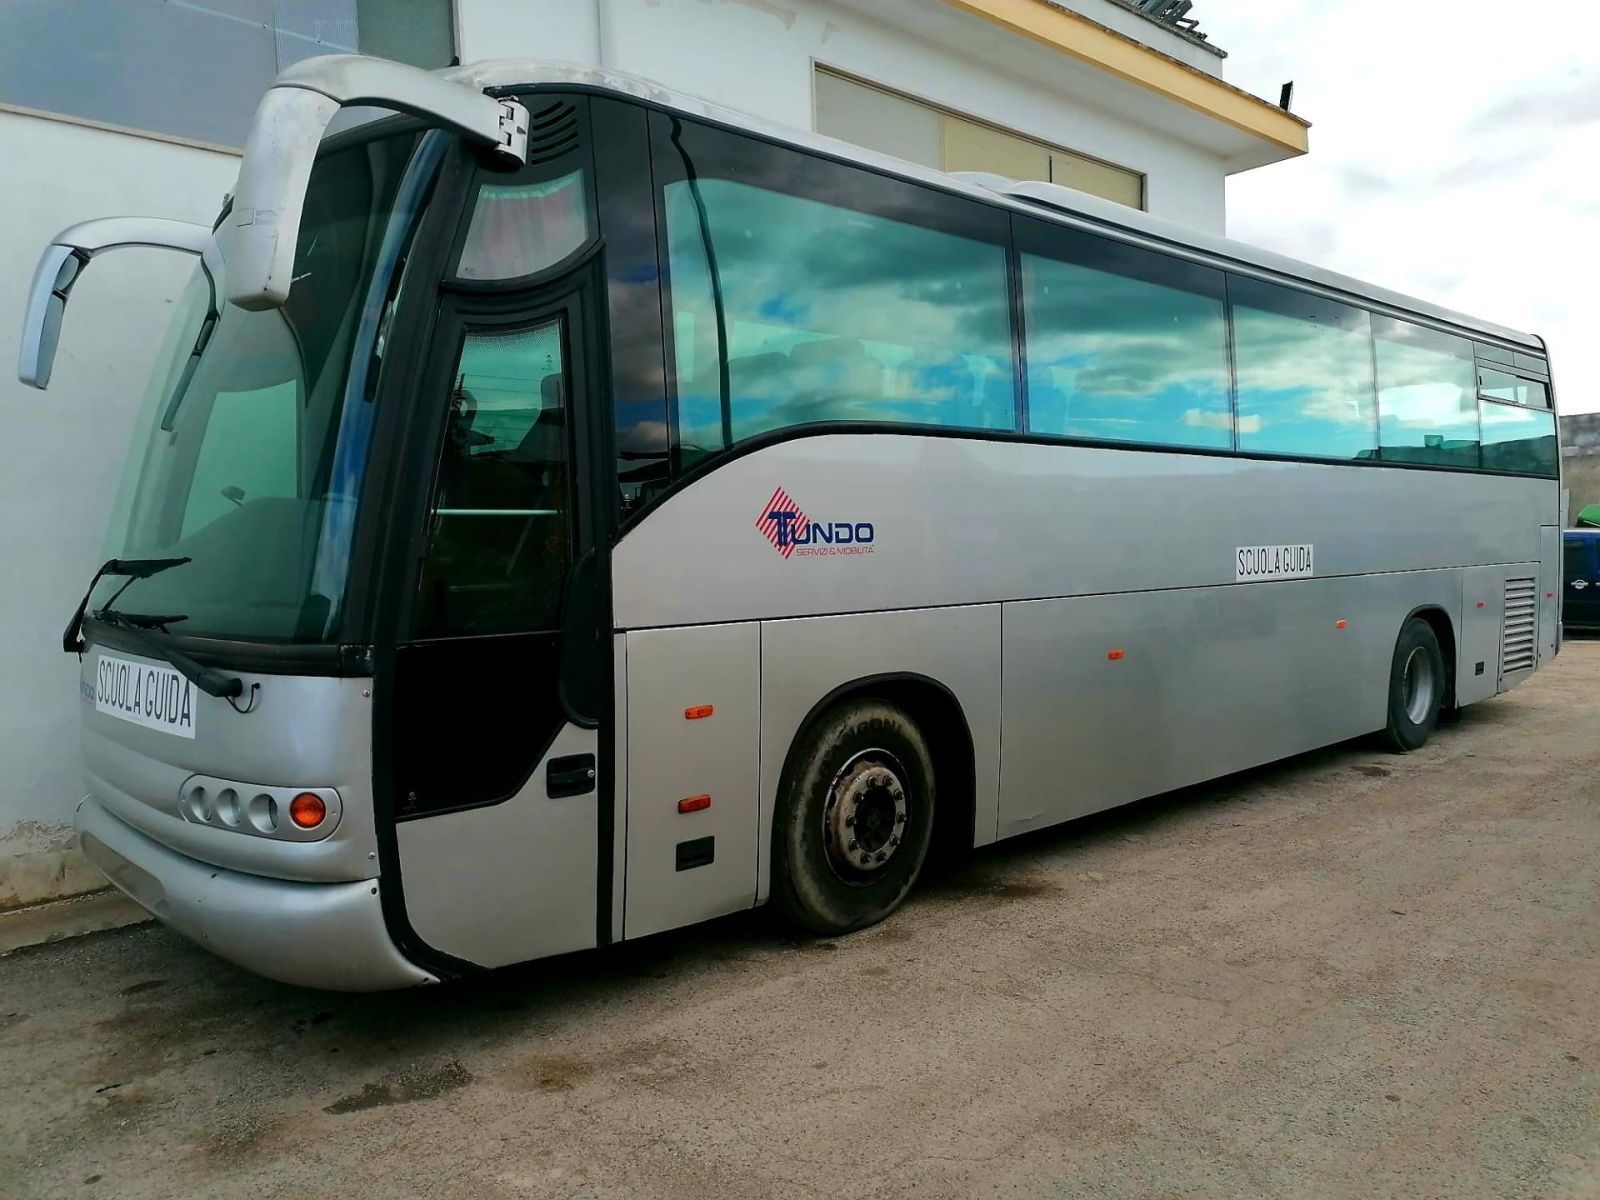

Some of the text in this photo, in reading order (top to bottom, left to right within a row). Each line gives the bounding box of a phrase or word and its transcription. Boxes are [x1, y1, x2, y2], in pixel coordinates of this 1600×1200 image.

[767, 511, 874, 546] TUNDO
[796, 547, 828, 556] SERVIZI
[829, 547, 836, 555] &
[1238, 546, 1312, 576] SCUOLA GUIDA
[98, 659, 191, 728] SCUOLA GUIDA
